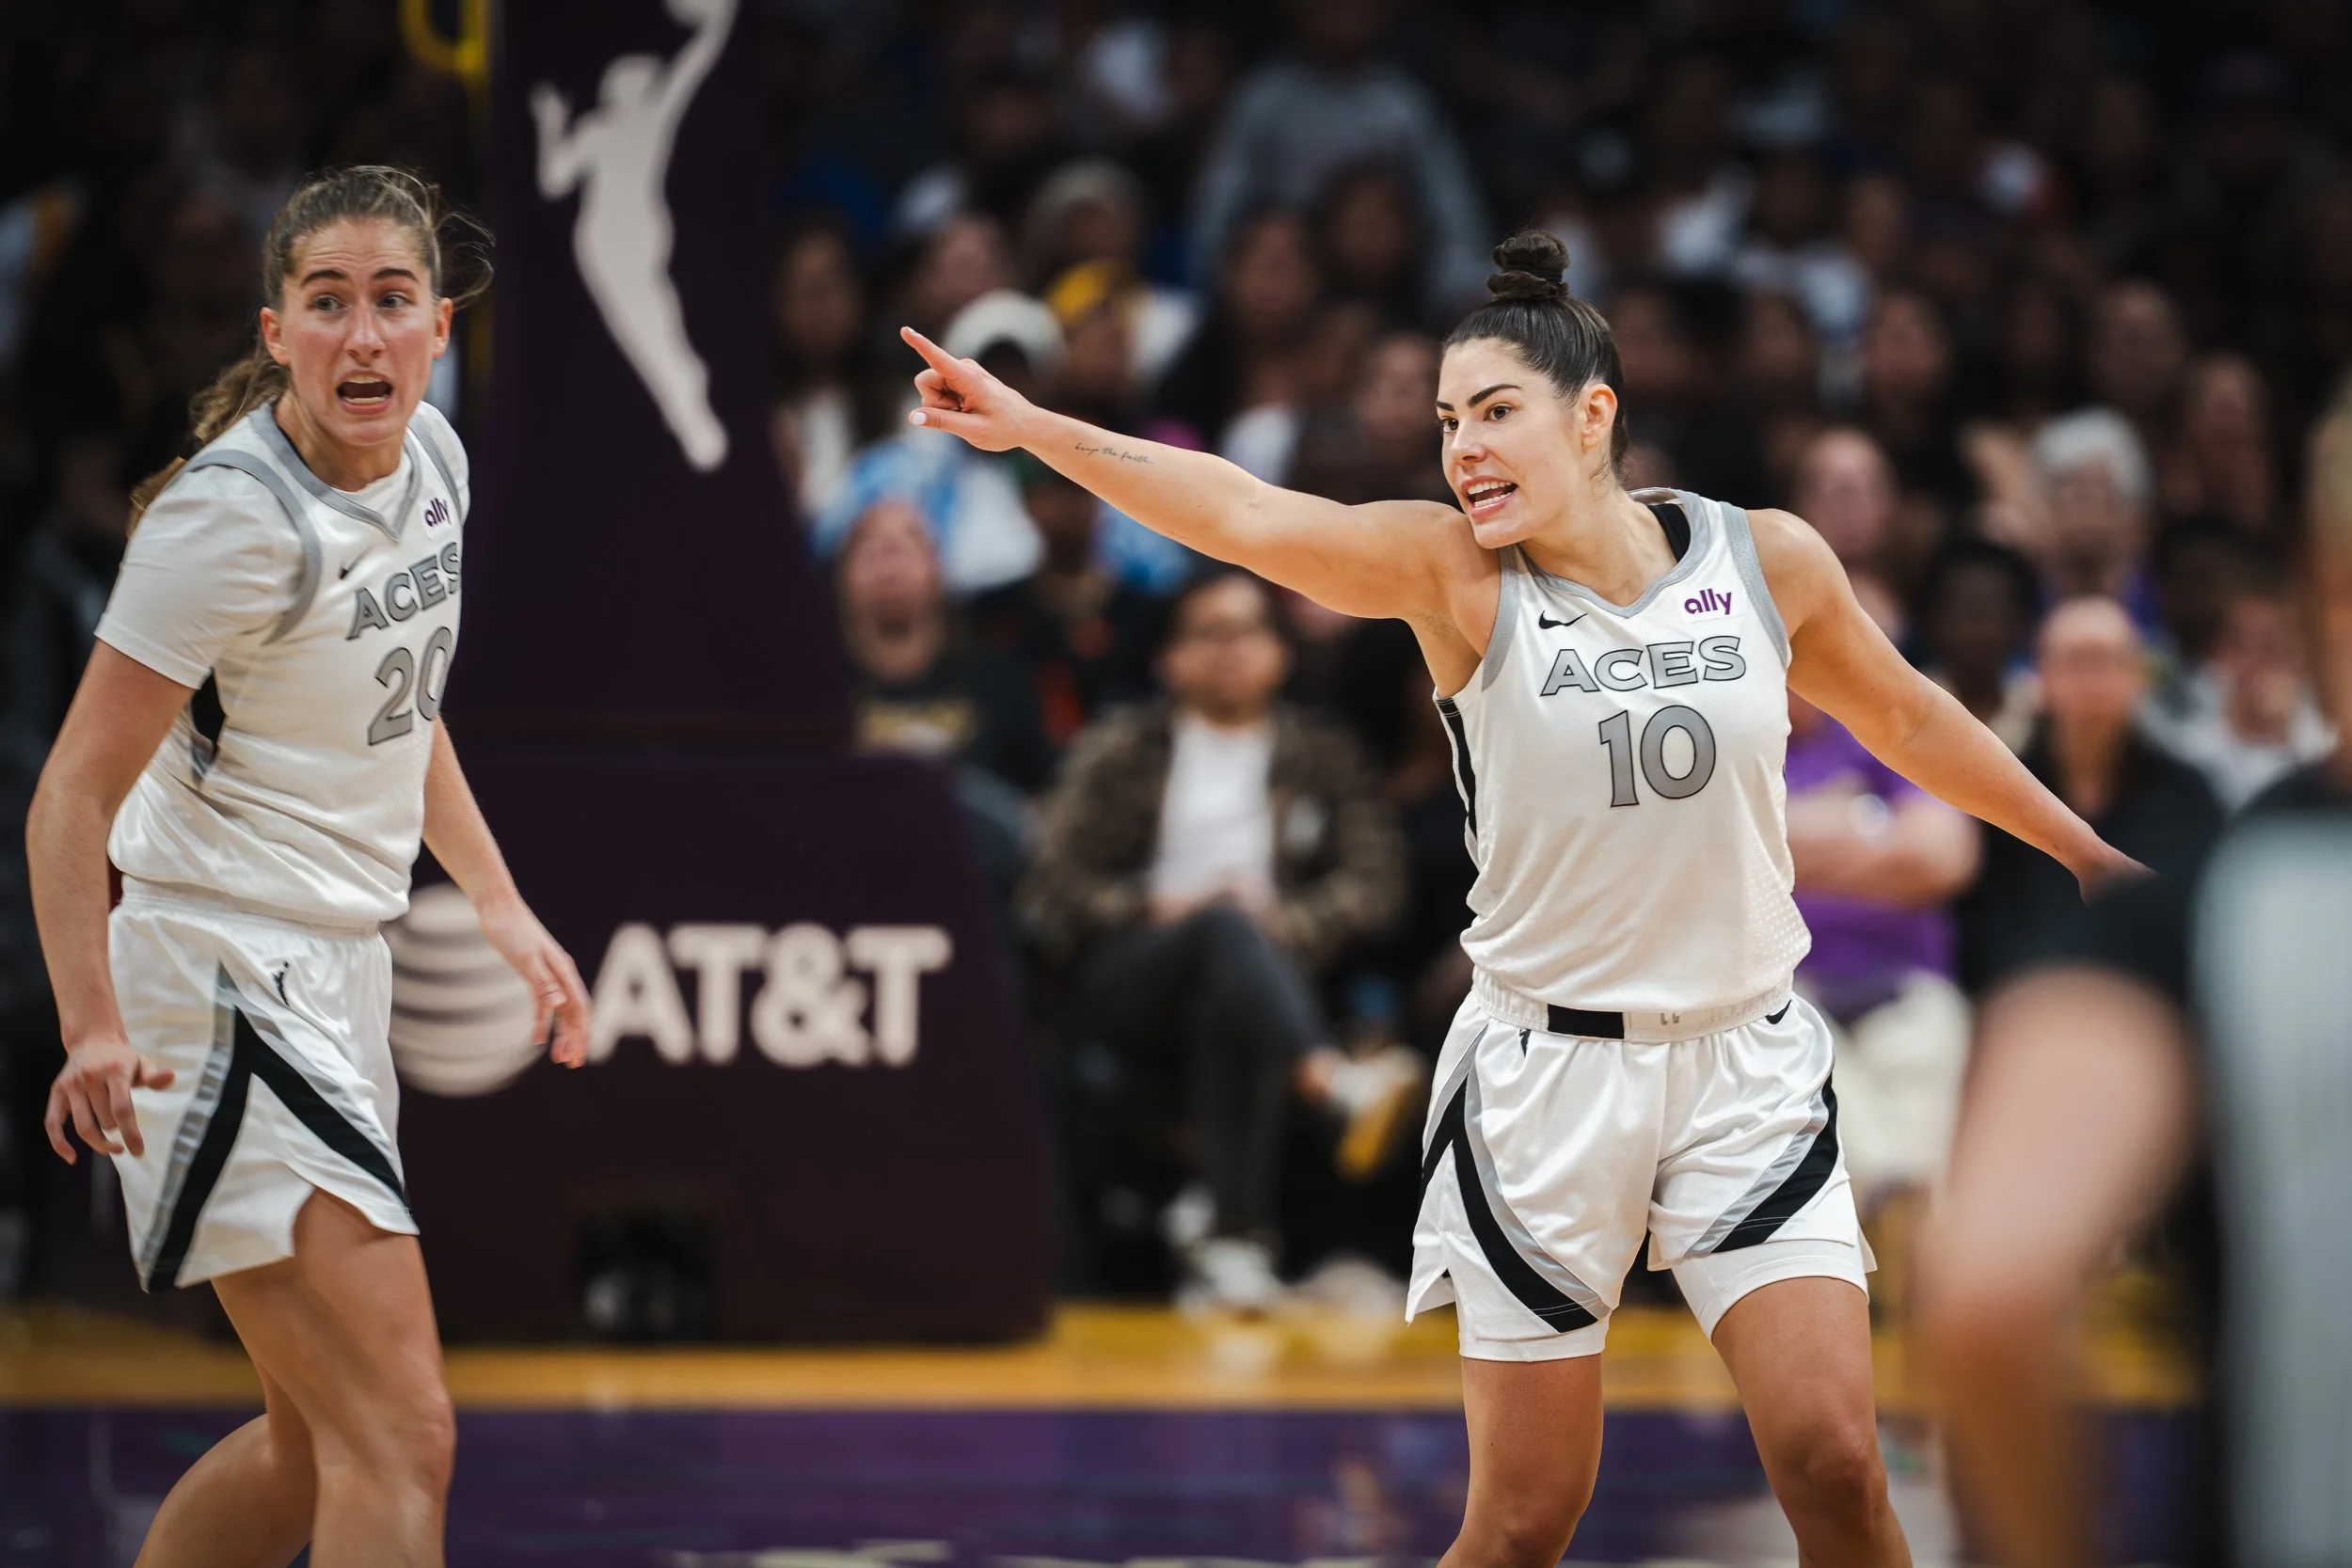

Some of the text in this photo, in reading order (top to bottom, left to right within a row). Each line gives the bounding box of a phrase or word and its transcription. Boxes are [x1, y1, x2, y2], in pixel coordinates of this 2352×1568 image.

[424, 497, 453, 527] ally
[344, 542, 459, 641] ACES
[1683, 588, 1733, 616] ally
[367, 626, 453, 746] 20
[1540, 636, 1747, 697] ACES
[1598, 705, 1717, 808] 10
[587, 923, 952, 1069] AT&T
